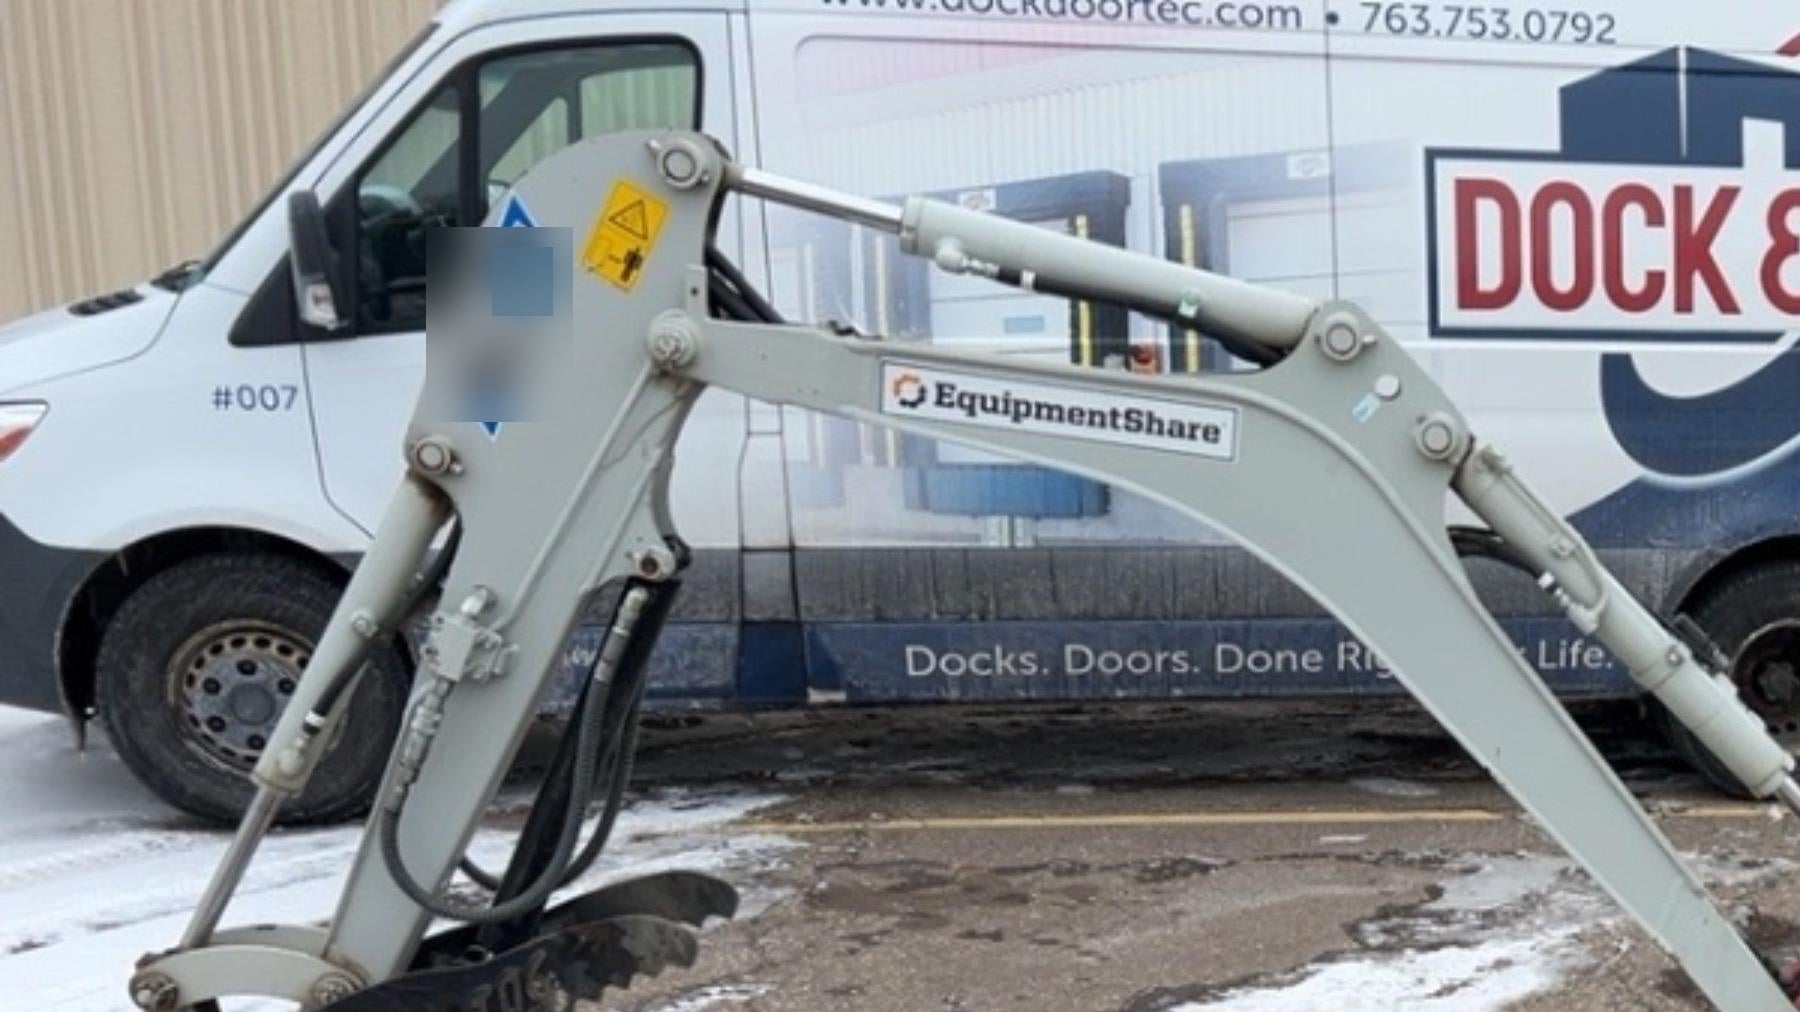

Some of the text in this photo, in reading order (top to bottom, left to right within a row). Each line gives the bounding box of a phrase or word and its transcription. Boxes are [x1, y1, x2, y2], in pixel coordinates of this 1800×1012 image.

[822, 0, 1617, 45] .ockdoortec.com 763.753.0792
[1453, 177, 1743, 315] DOCK
[211, 384, 298, 411] #007
[934, 381, 1222, 444] EquipmentShare
[905, 644, 1049, 676] Docks.
[1064, 643, 1199, 675] Doors.
[1215, 642, 1323, 673] Done
[1539, 638, 1613, 670] Life.
